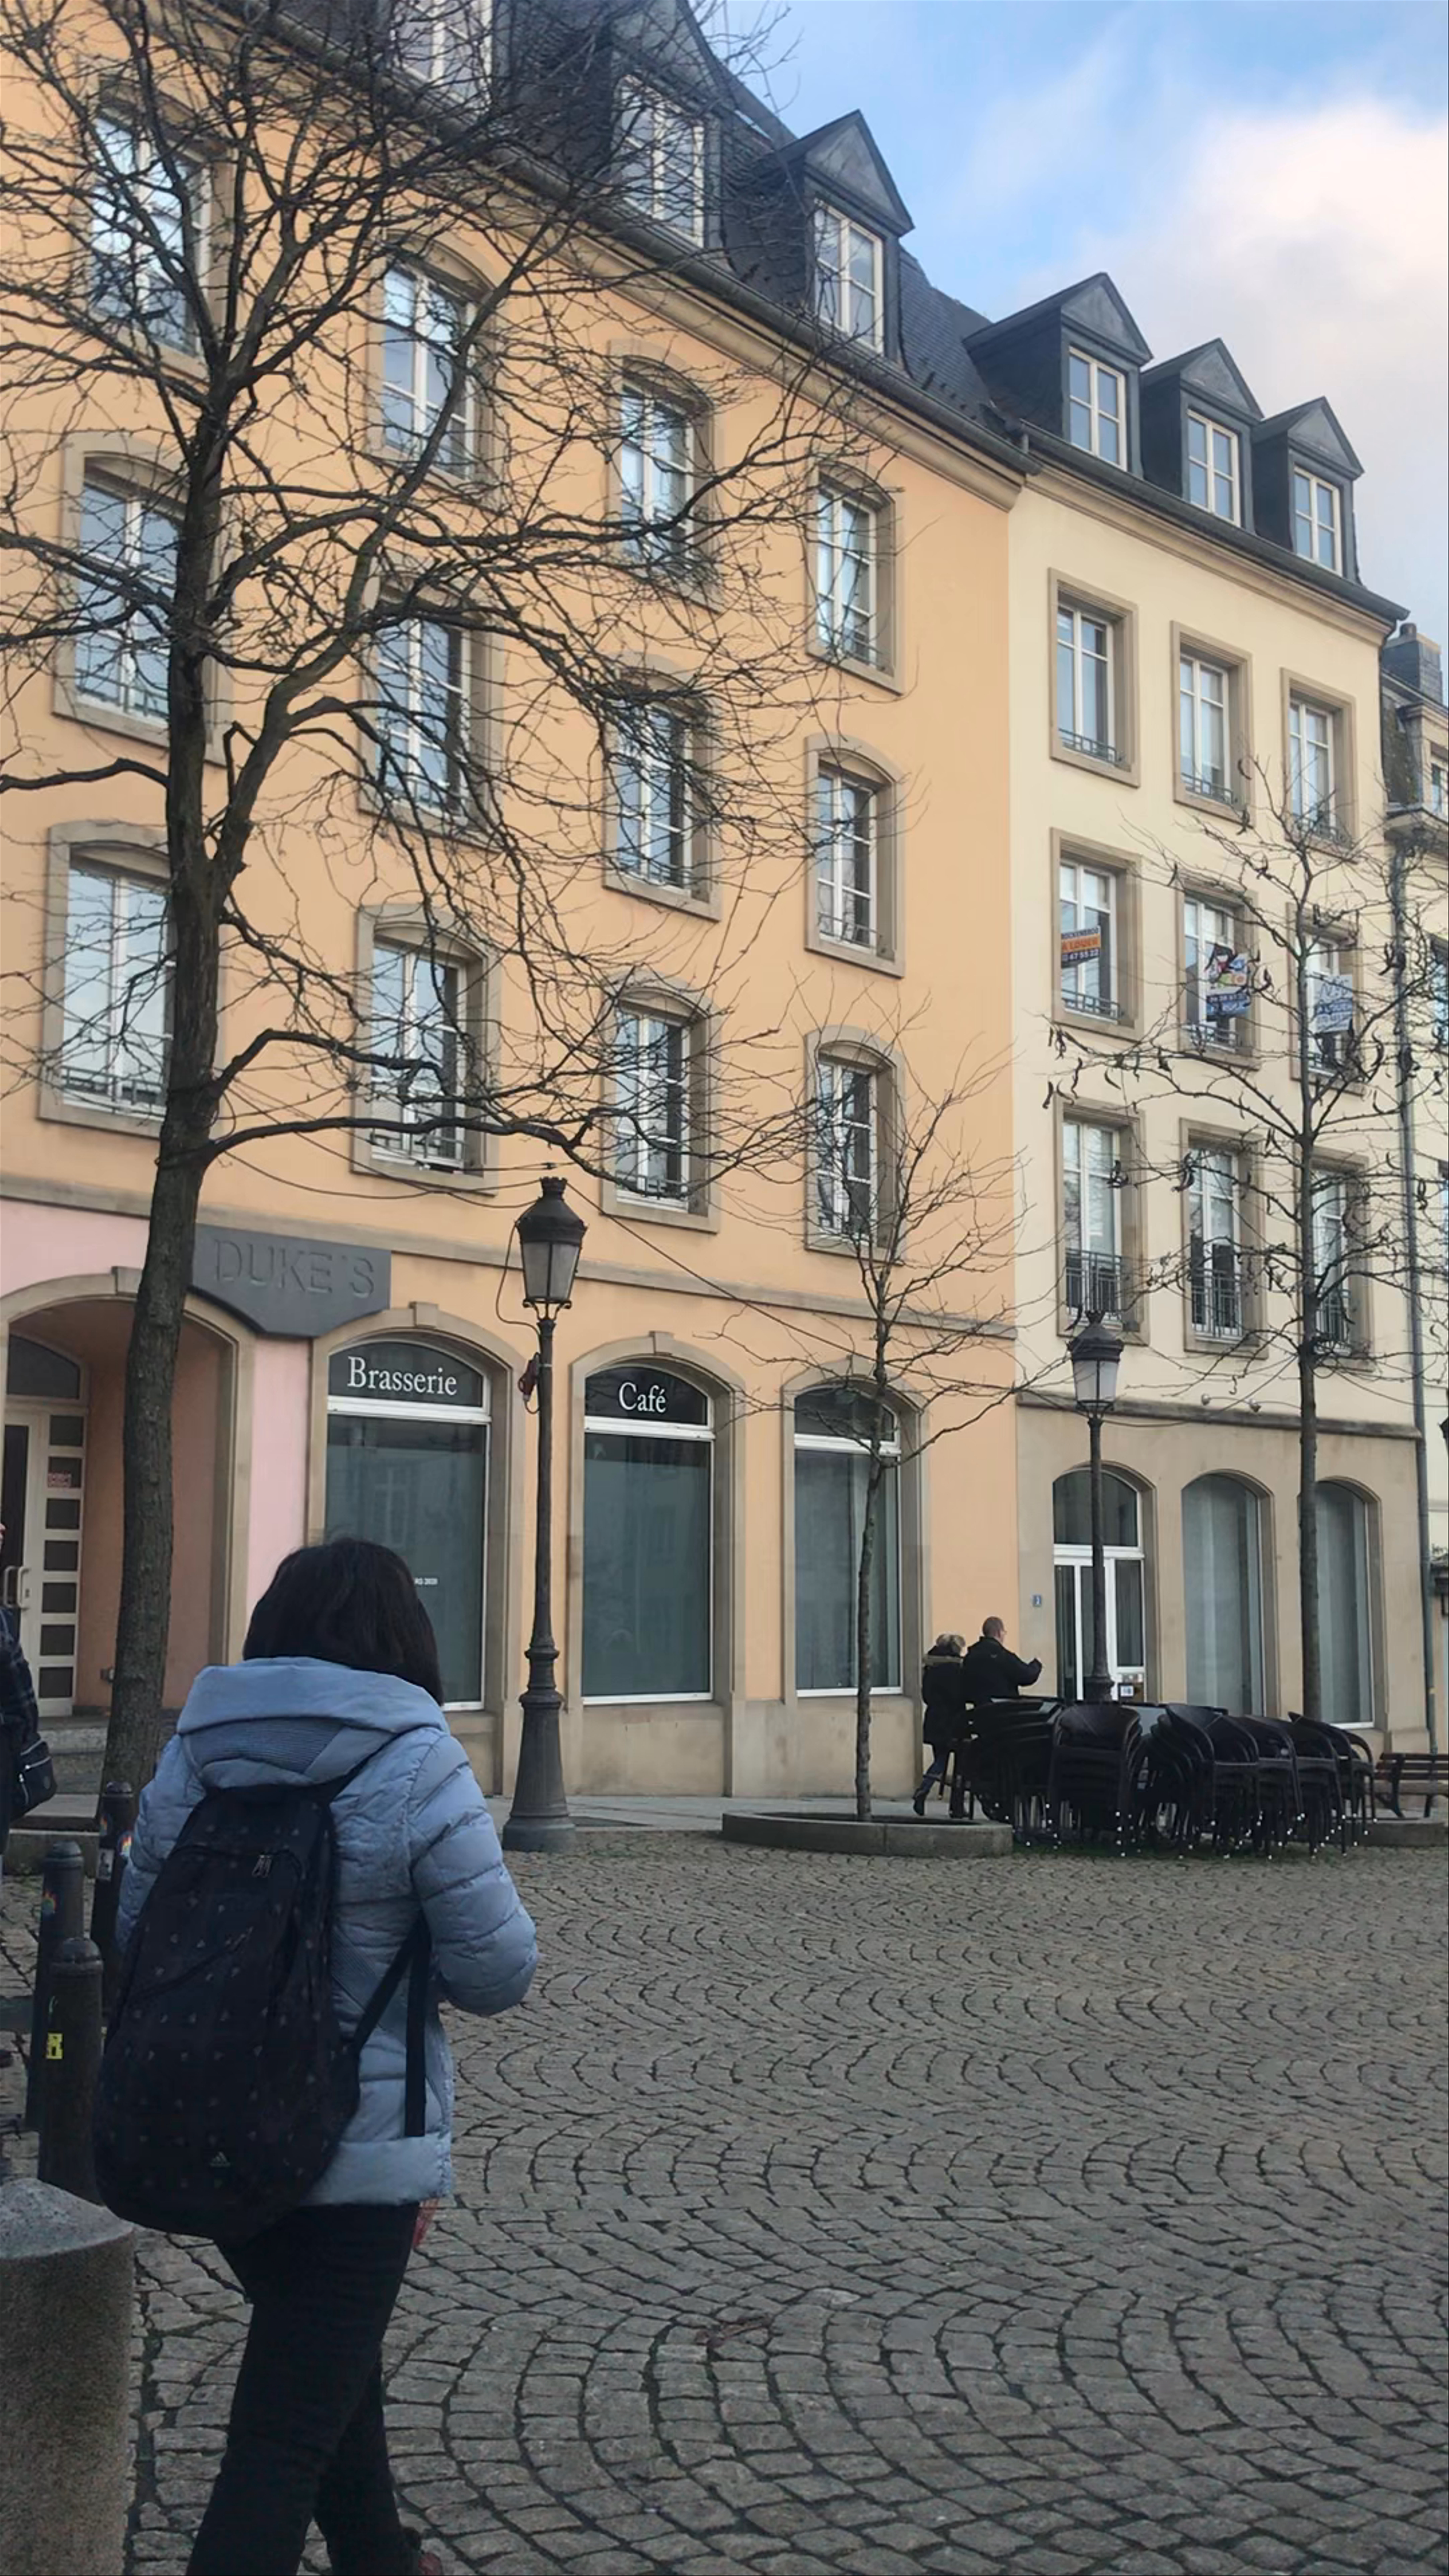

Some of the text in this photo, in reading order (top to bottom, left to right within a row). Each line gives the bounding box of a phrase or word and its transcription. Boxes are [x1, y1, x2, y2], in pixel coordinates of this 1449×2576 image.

[214, 1239, 375, 1299] DUKE'S
[347, 1356, 457, 1395] Brasserie
[619, 1382, 666, 1413] Café
